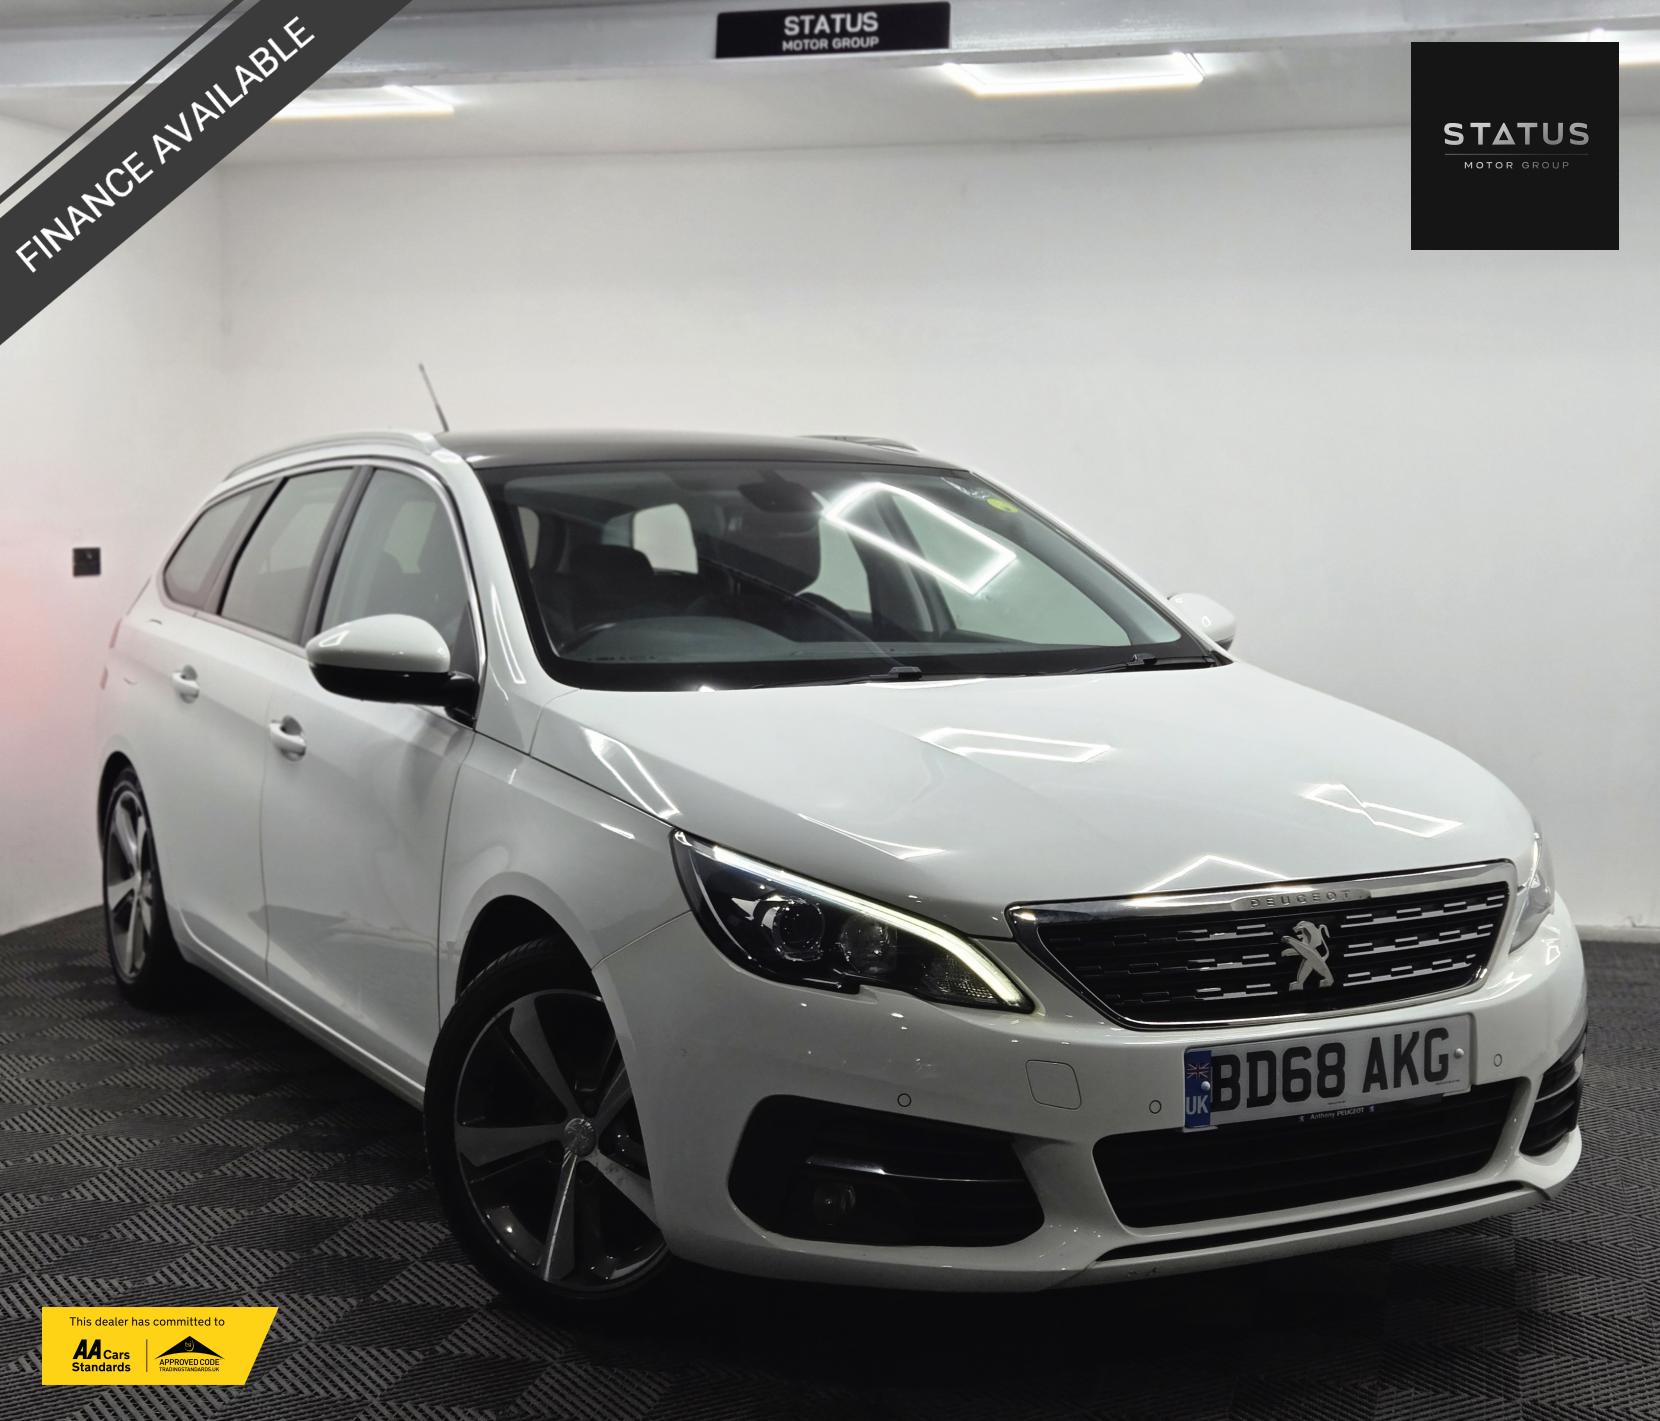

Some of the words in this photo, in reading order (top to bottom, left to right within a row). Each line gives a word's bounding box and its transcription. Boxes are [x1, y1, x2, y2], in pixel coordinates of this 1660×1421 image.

[784, 12, 879, 36] STATUS
[782, 39, 829, 52] MOTOR
[832, 36, 879, 49] GROUP
[1251, 891, 1351, 908] PEUGEOT
[1211, 1042, 1346, 1112] BD68
[1362, 1027, 1449, 1093] AKG
[1185, 1095, 1209, 1116] UK
